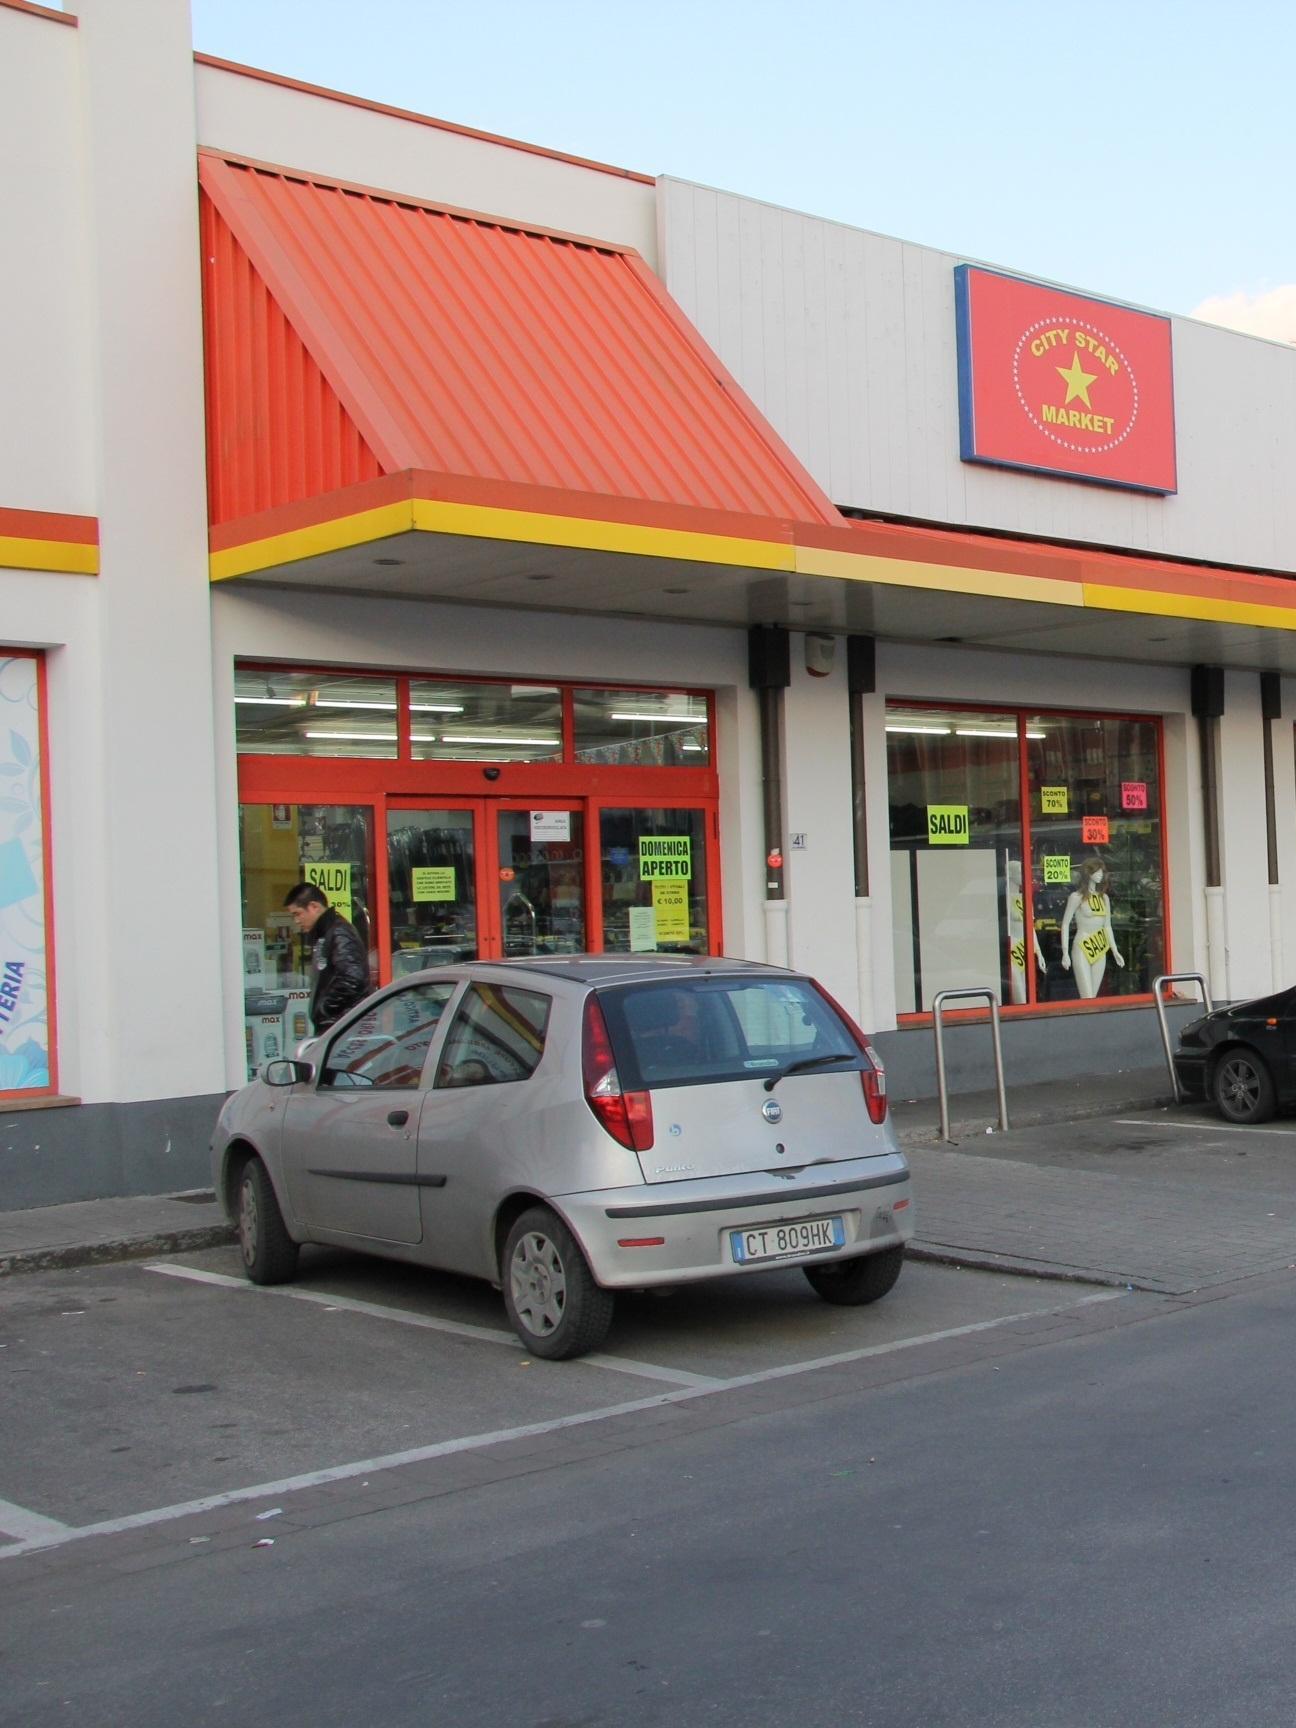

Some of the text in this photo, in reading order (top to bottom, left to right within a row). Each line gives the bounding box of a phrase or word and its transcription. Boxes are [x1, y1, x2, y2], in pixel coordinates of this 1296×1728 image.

[1030, 328, 1120, 376] CITY STAR
[1041, 403, 1115, 435] MARKET
[1124, 783, 1146, 792] SCONTO
[1046, 799, 1063, 808] 70%
[1126, 794, 1143, 806] 50%
[929, 814, 967, 835] SALDI
[792, 835, 805, 846] 41
[1087, 829, 1105, 841] 30%
[641, 841, 689, 857] DOMENICA
[642, 860, 689, 876] APERTO
[1045, 858, 1069, 868] SCONTO
[309, 868, 348, 892] SALDI
[1046, 870, 1068, 880] 20%
[243, 933, 262, 941] max
[1082, 928, 1107, 958] SALDI
[289, 991, 312, 1000] max
[261, 1016, 281, 1024] max
[746, 1222, 833, 1256] CT 809HK
